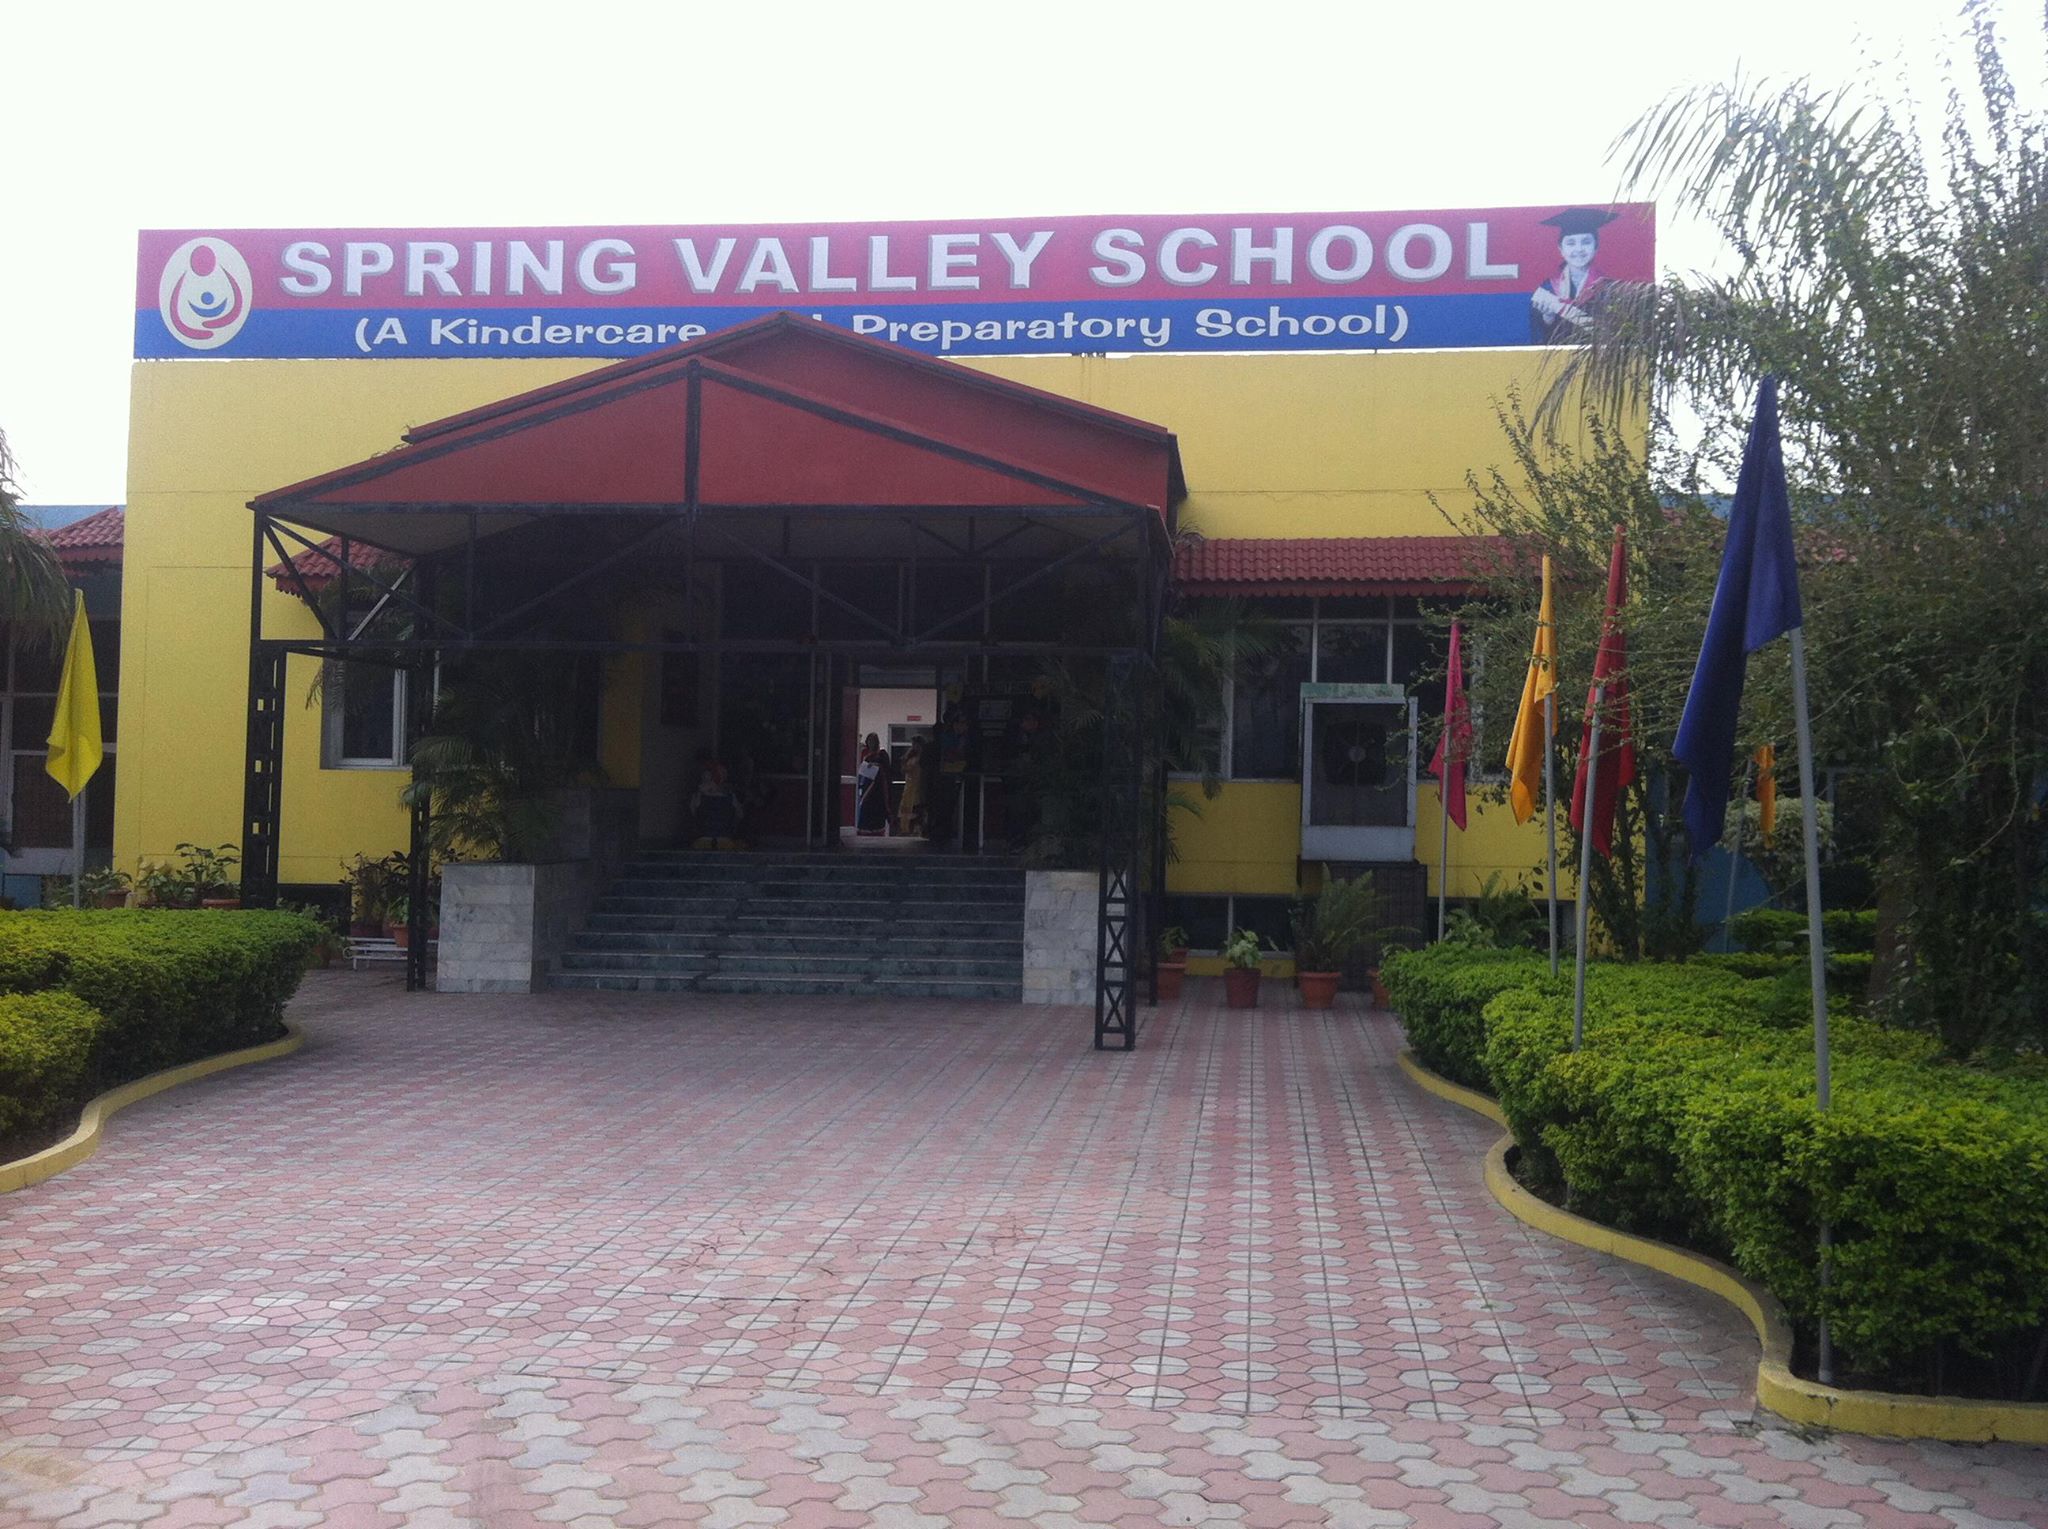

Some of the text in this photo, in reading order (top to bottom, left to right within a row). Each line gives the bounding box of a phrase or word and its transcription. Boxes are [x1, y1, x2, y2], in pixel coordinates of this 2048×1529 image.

[279, 221, 1520, 297] SPRING VALLEY SCHOOL
[354, 304, 1409, 353] (A Kindercare Preparatory School)
